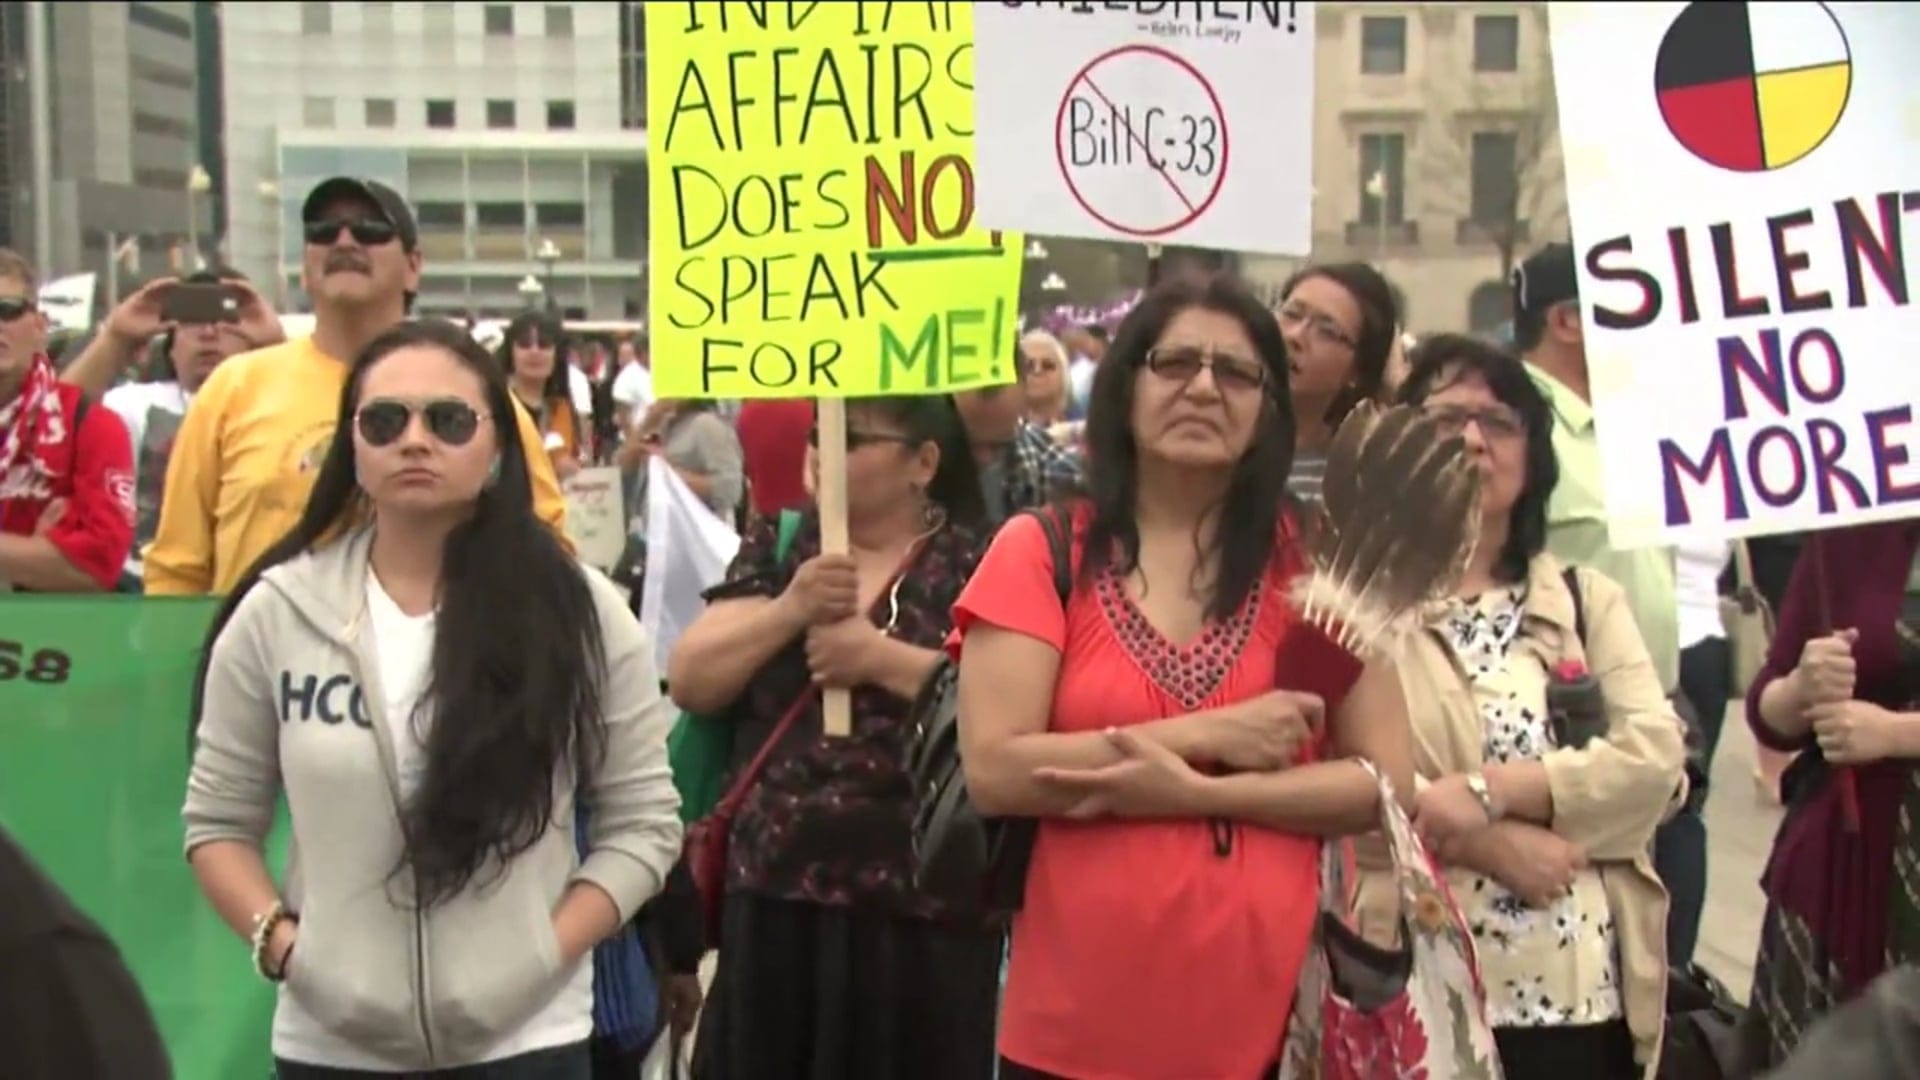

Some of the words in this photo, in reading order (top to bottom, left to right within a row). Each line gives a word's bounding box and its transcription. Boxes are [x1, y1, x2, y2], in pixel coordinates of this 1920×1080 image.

[665, 42, 974, 152] AFFAIRS
[1070, 97, 1132, 167] Bill
[1145, 107, 1217, 177] C-33
[672, 165, 850, 251] DOES
[864, 150, 1002, 248] NO
[667, 251, 899, 329] SPEAK
[702, 338, 842, 392] FOR
[879, 296, 1005, 390] ME!
[1717, 327, 1846, 420] NO
[1658, 404, 1920, 527] MORE
